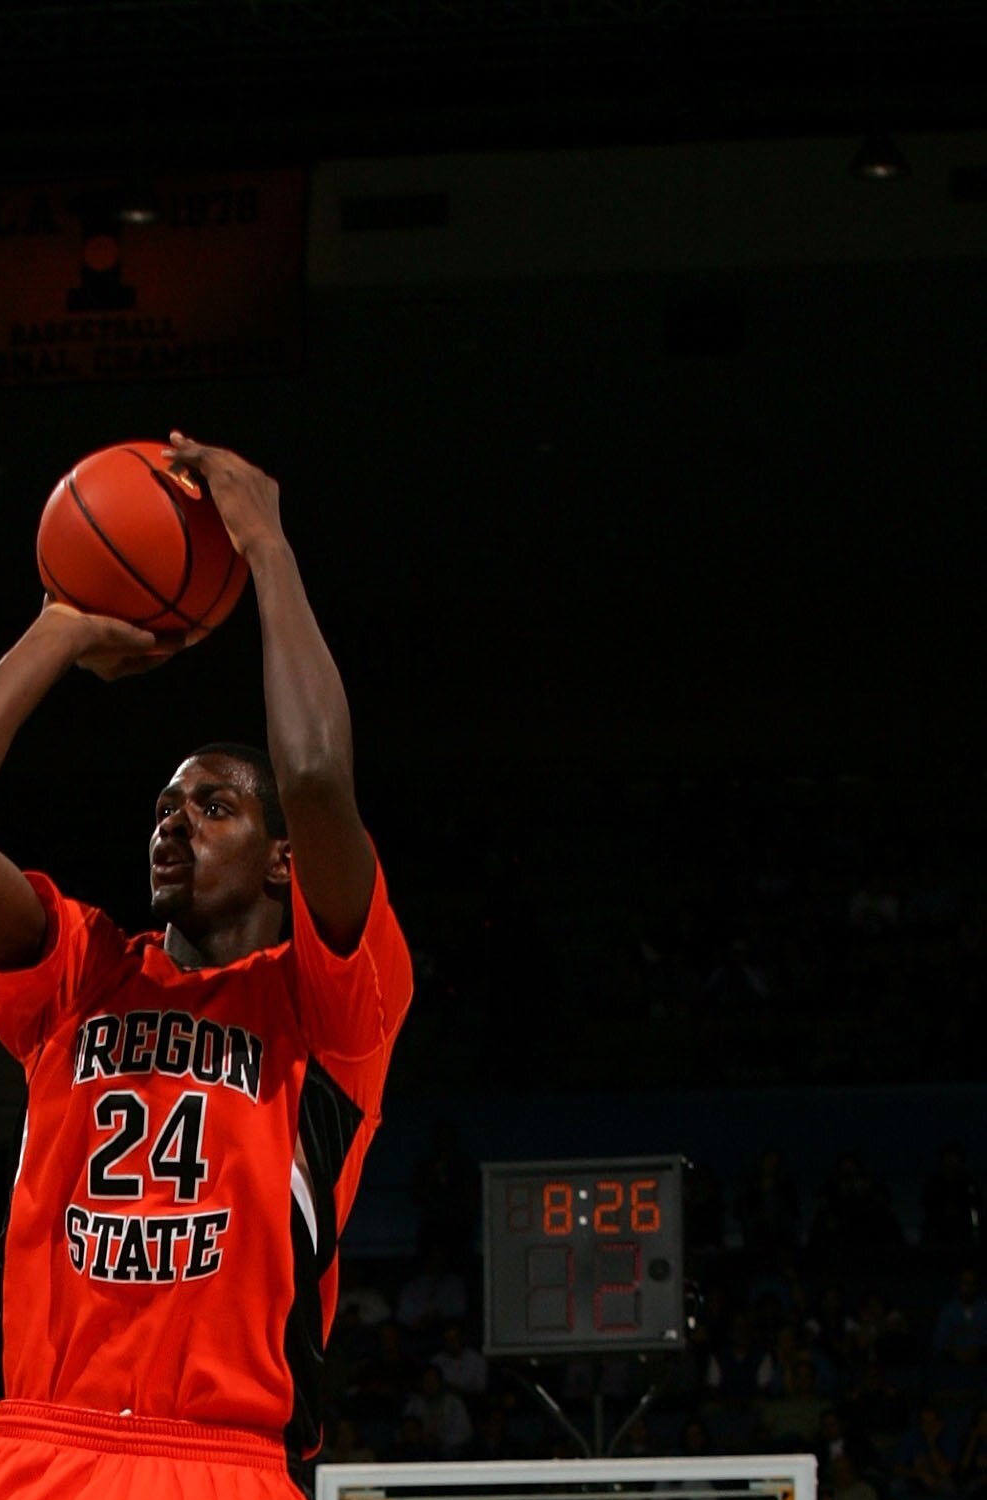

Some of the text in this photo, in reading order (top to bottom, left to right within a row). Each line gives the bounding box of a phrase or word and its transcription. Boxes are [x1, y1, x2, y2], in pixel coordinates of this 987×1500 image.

[10, 316, 178, 346] BASKETBALL
[72, 1009, 263, 1104] REGON
[88, 1090, 208, 1203] 24
[65, 1203, 231, 1285] STATE
[542, 1179, 662, 1237] 8:26
